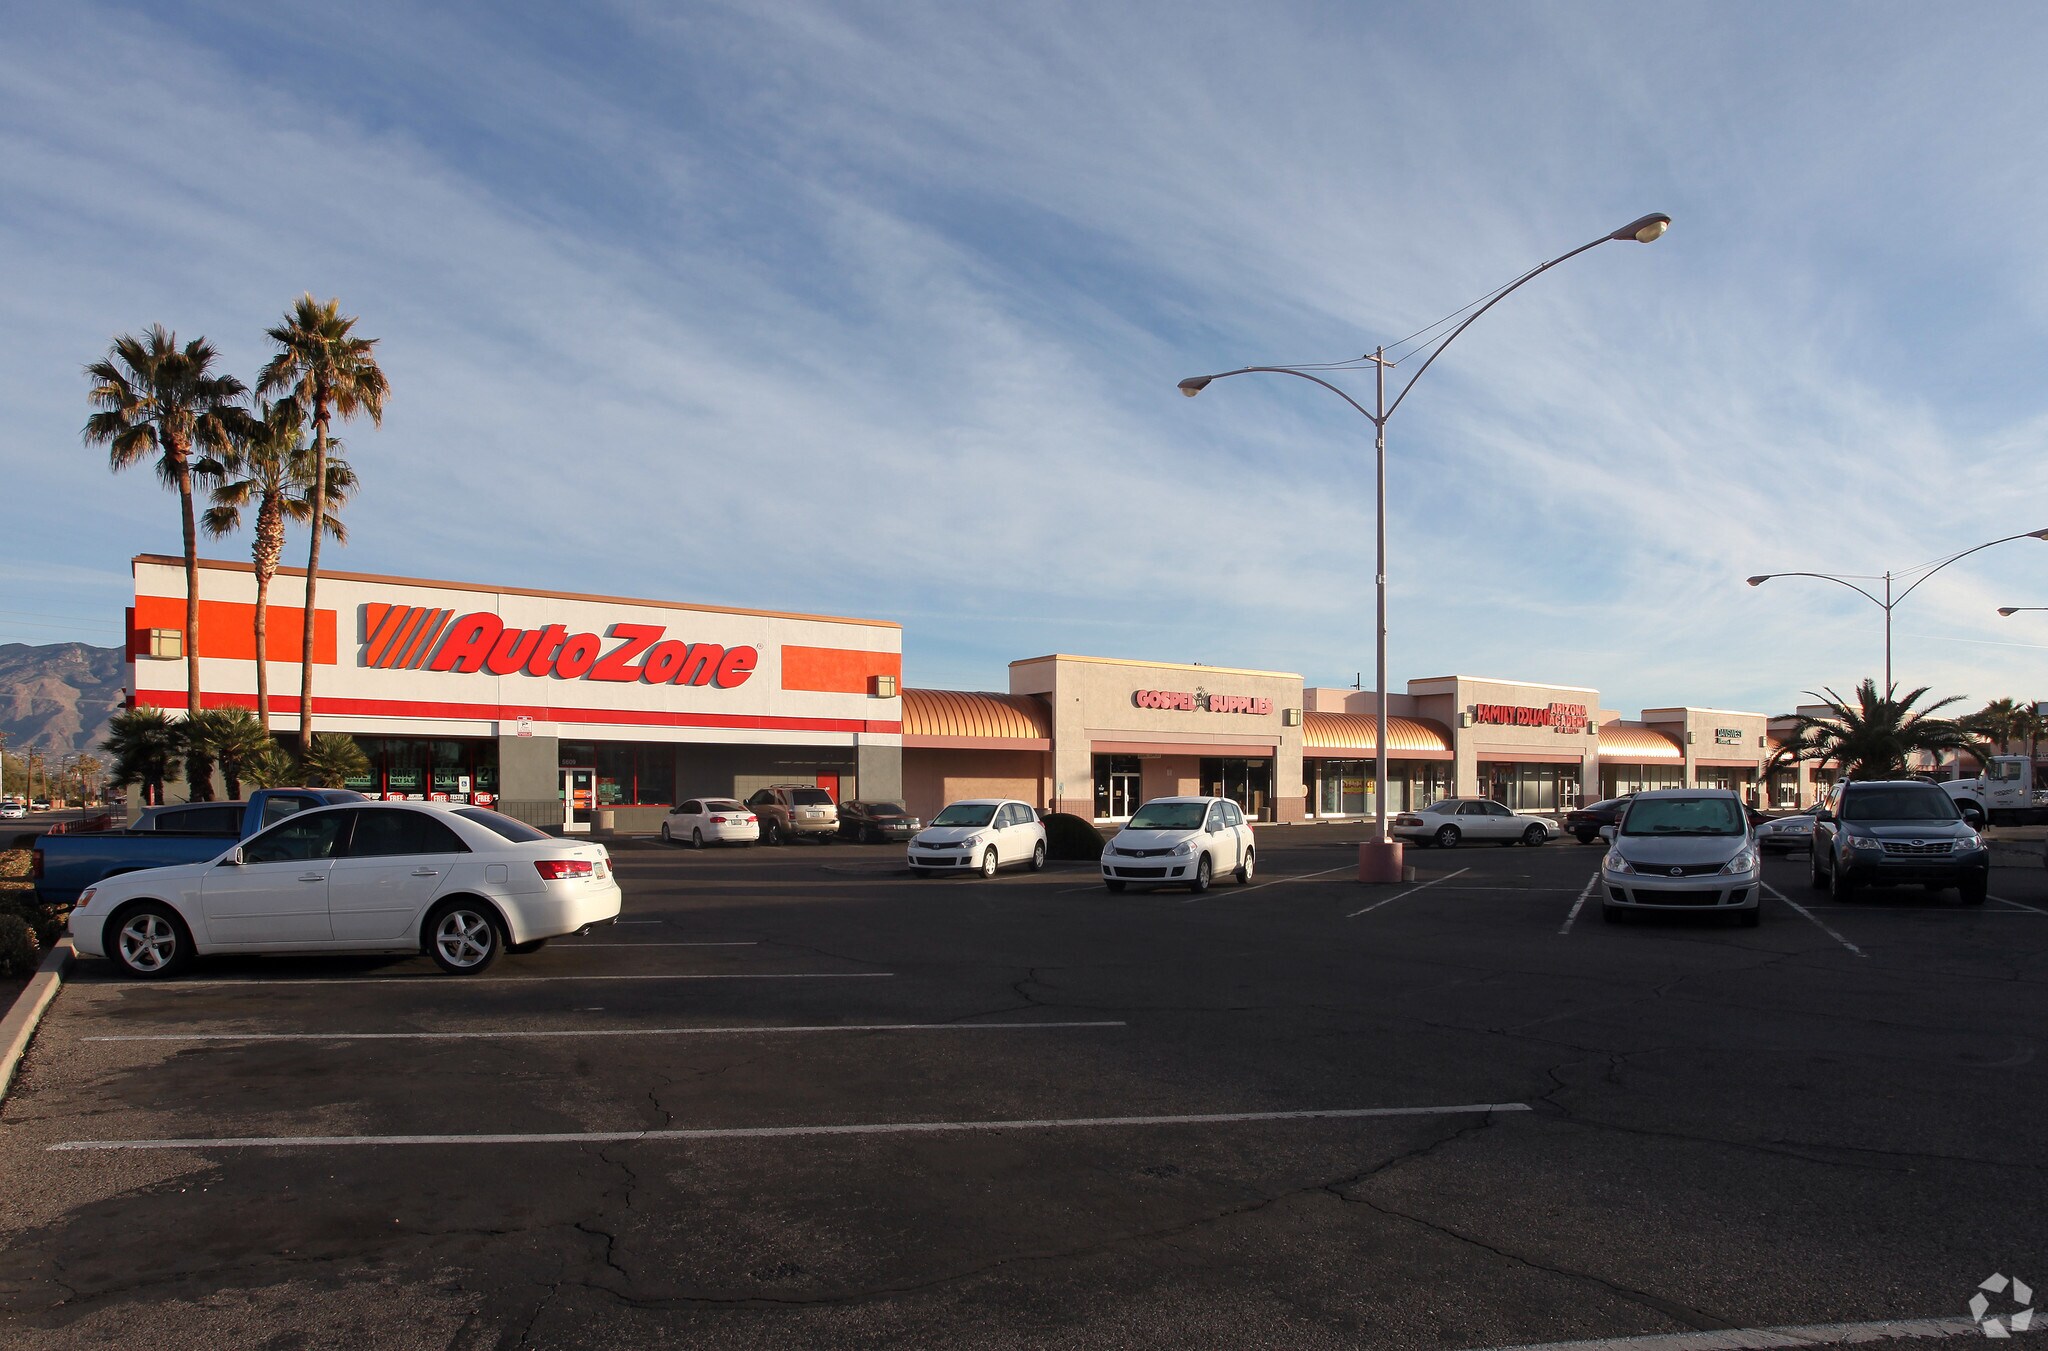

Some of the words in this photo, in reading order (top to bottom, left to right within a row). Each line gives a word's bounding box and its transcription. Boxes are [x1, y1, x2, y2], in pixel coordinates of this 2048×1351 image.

[430, 611, 759, 689] AutoZone
[1136, 689, 1196, 711] GOSPEL
[1209, 694, 1274, 715] SUPPLIES
[1476, 704, 1516, 724] FAMILY
[1550, 702, 1588, 716] ARIZONA
[1548, 715, 1589, 728] ACADEMY
[391, 768, 412, 778] SAVE
[433, 794, 447, 802] FREE
[477, 794, 491, 802] FREE
